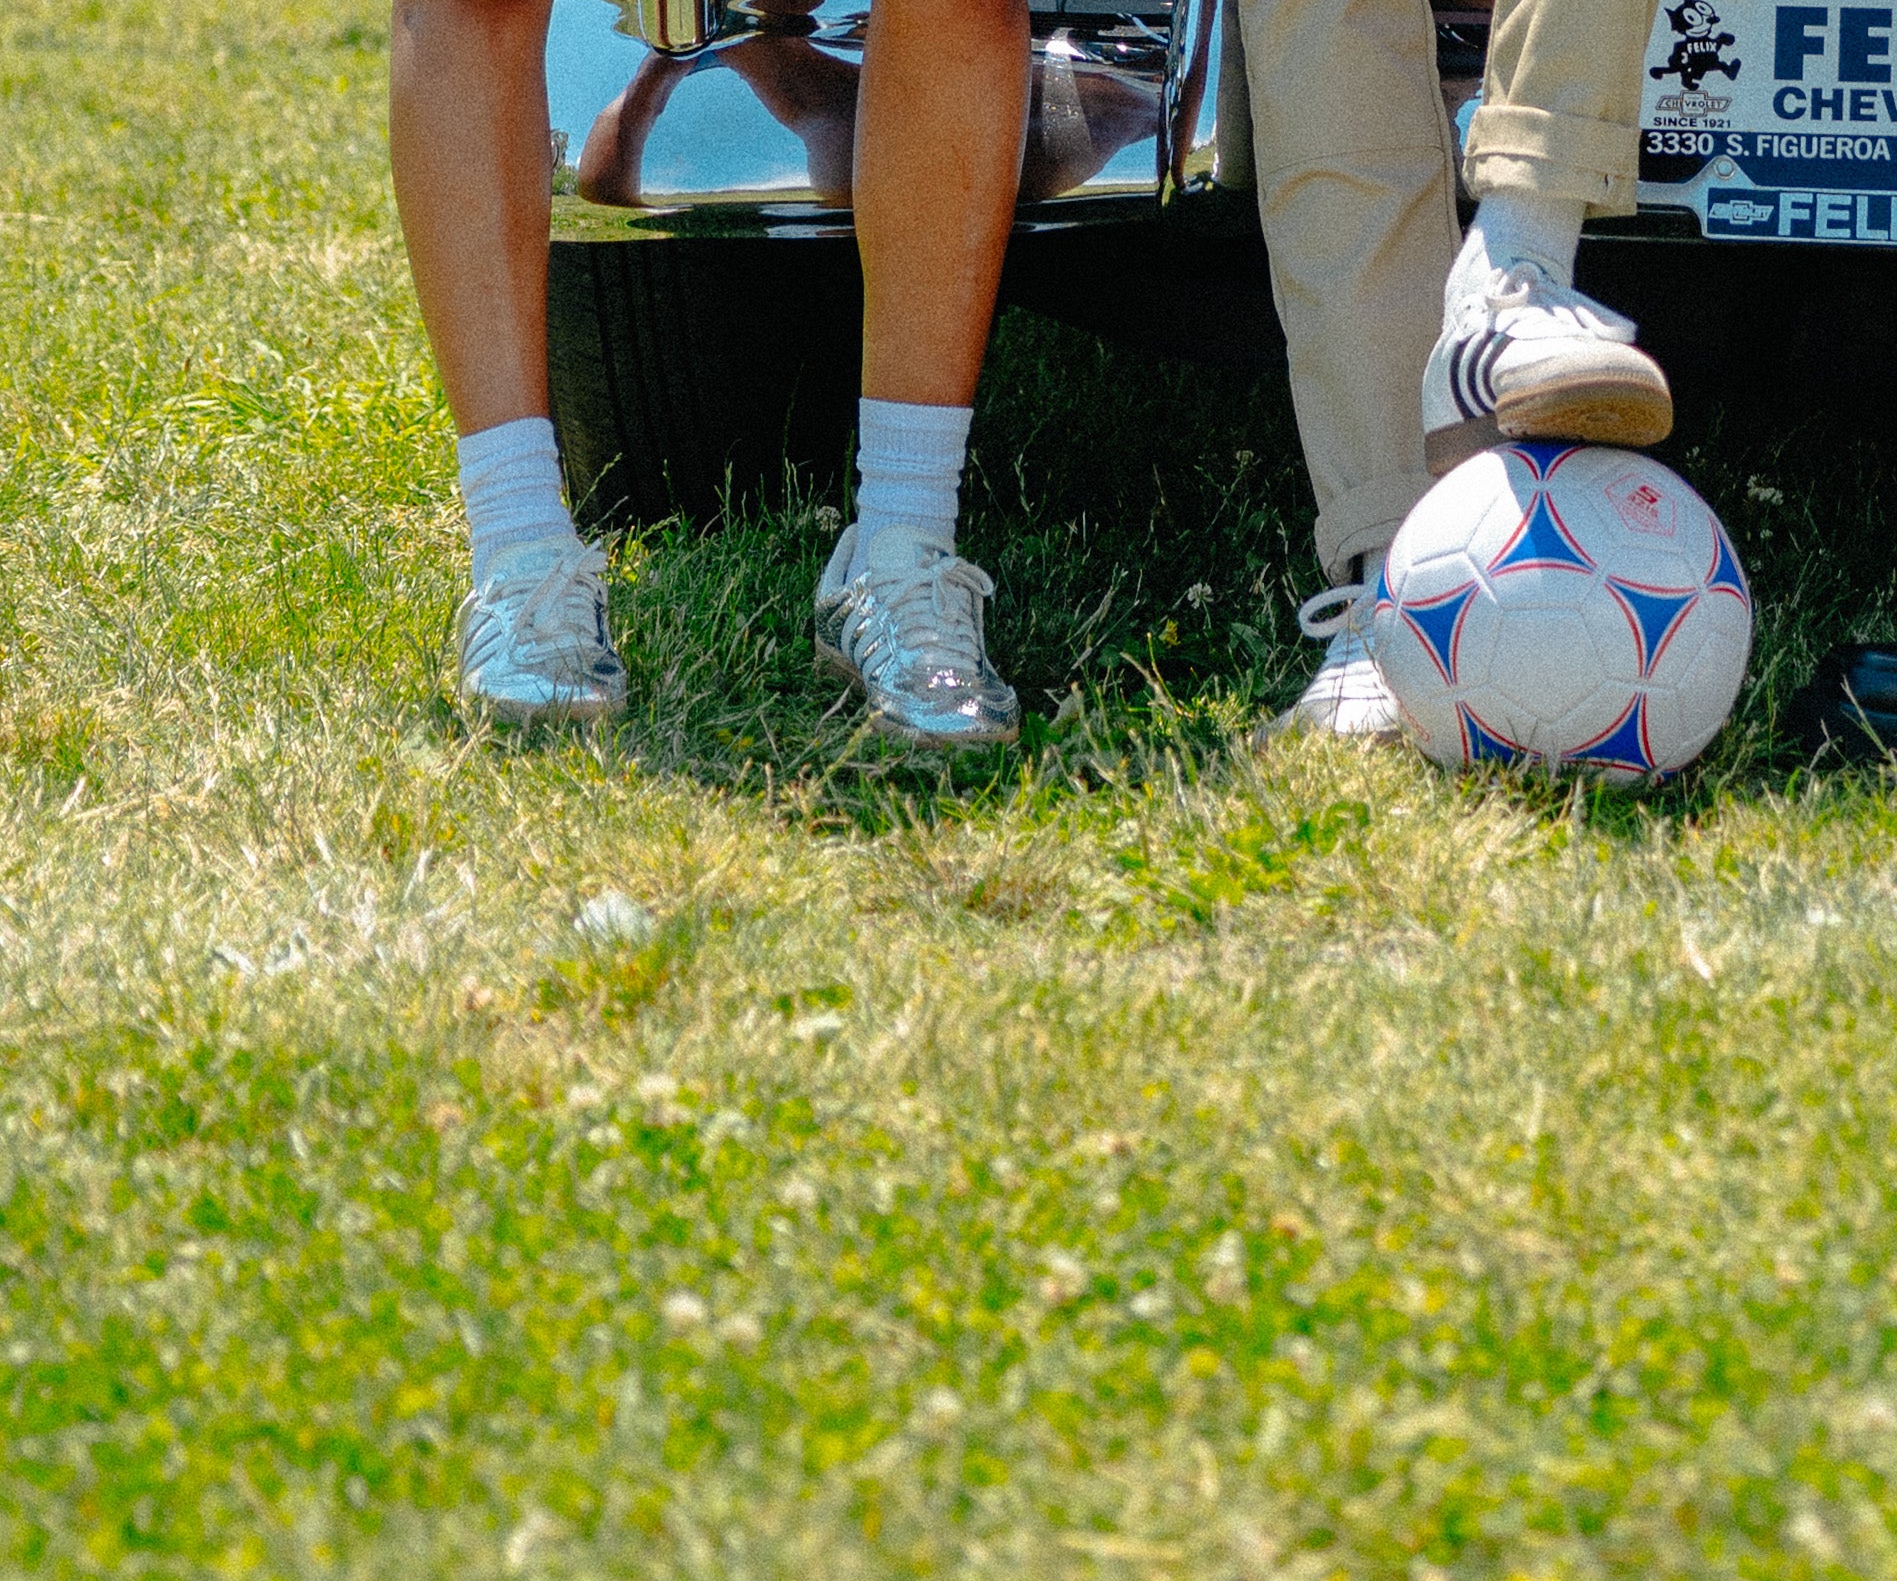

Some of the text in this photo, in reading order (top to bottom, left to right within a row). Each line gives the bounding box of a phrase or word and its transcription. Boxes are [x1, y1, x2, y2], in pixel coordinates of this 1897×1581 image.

[1687, 41, 1717, 54] FELIX
[1653, 116, 1732, 129] SINCE 1921
[1646, 131, 1715, 156] 3330
[1726, 134, 1750, 156] S.
[1756, 134, 1891, 162] FIGUEROA
